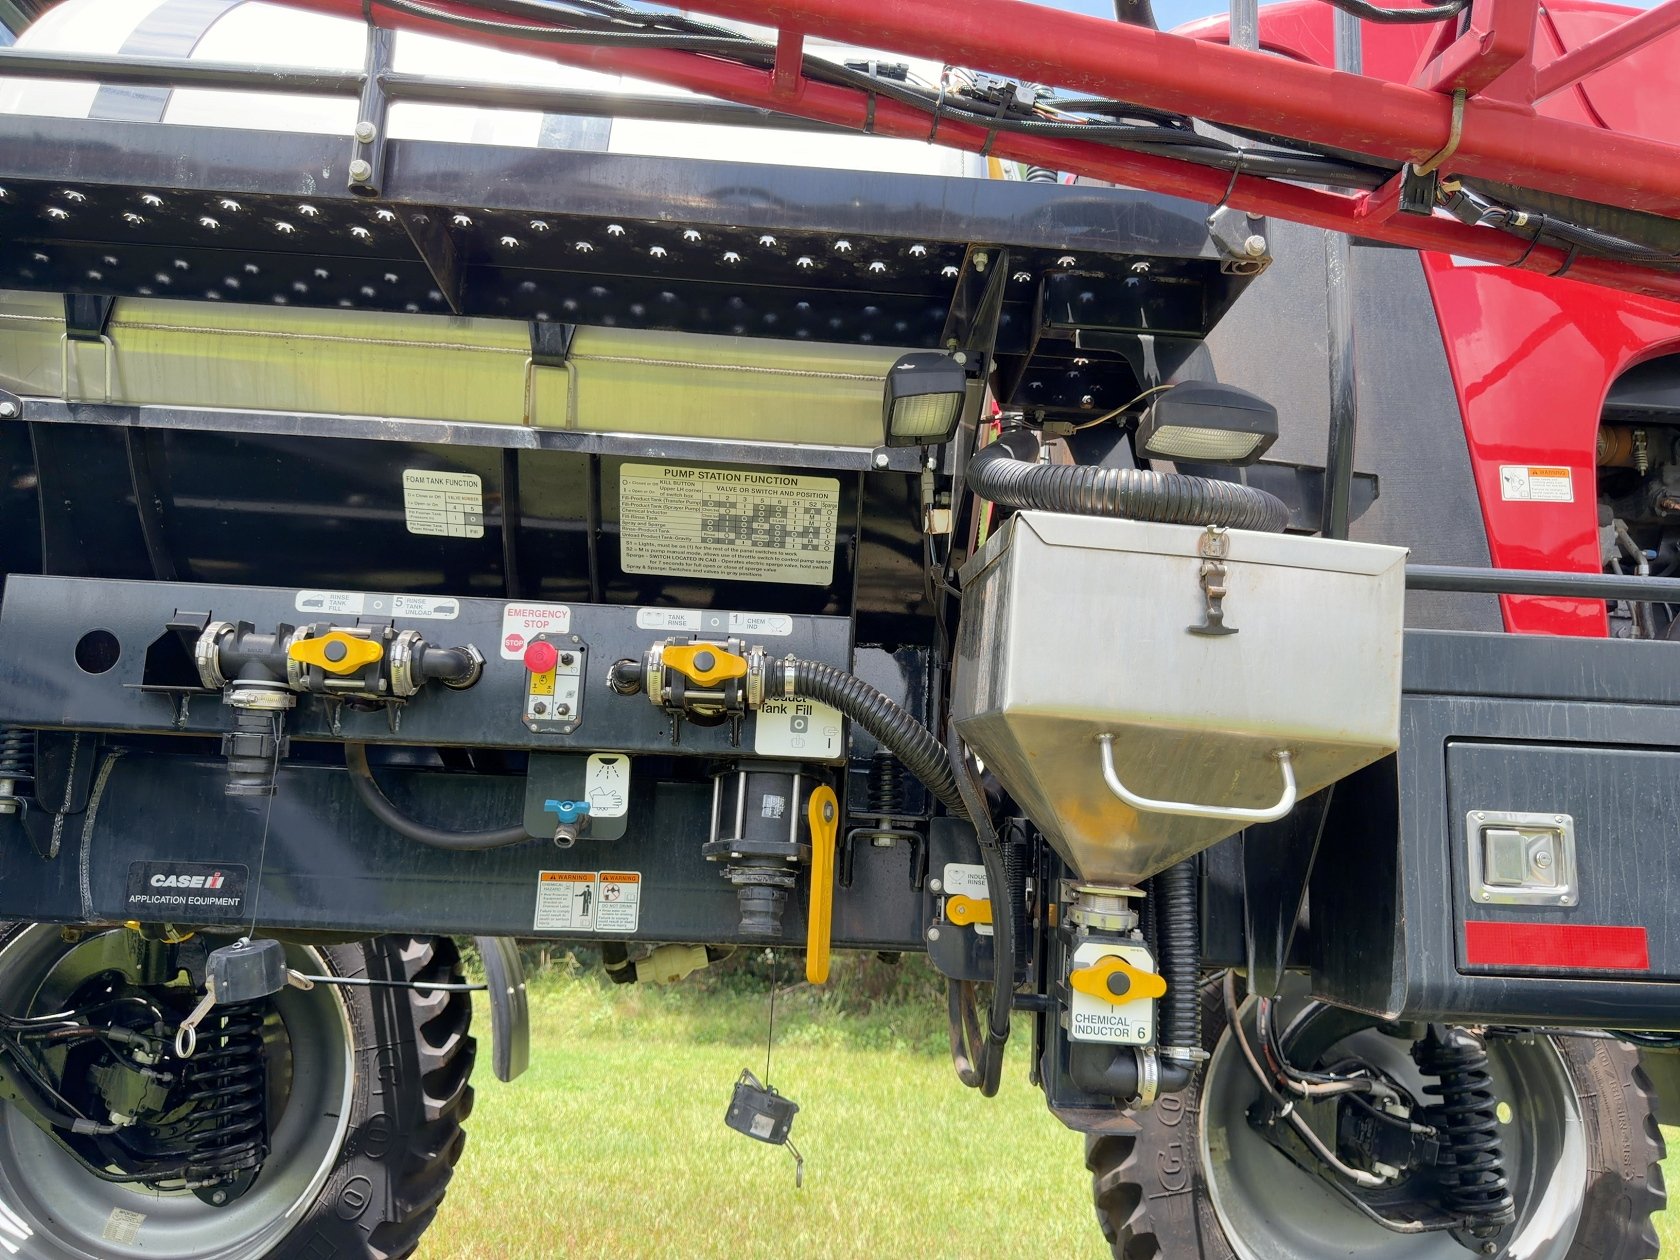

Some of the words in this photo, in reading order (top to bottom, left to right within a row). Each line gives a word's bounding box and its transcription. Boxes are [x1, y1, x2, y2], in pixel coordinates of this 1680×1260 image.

[406, 475, 425, 483] FOAM
[426, 477, 444, 485] TANK
[446, 478, 478, 488] FUNCTION
[664, 468, 695, 478] PUMP
[698, 471, 741, 482] STATION
[744, 474, 798, 486] FUNCTION
[796, 491, 828, 499] POSITION
[395, 596, 403, 607] 5
[507, 608, 568, 619] EMERGENCY
[732, 614, 738, 624] 1
[524, 620, 550, 628] STOP
[760, 702, 787, 714] Tank
[795, 704, 812, 716] Fill
[150, 874, 206, 888] CASE
[128, 894, 186, 904] APPLICATION
[188, 896, 240, 906] EQUIPMENT
[1075, 1013, 1130, 1027] CHEMICAL
[1075, 1025, 1129, 1038] INDUCTOR
[1137, 1026, 1146, 1039] 6
